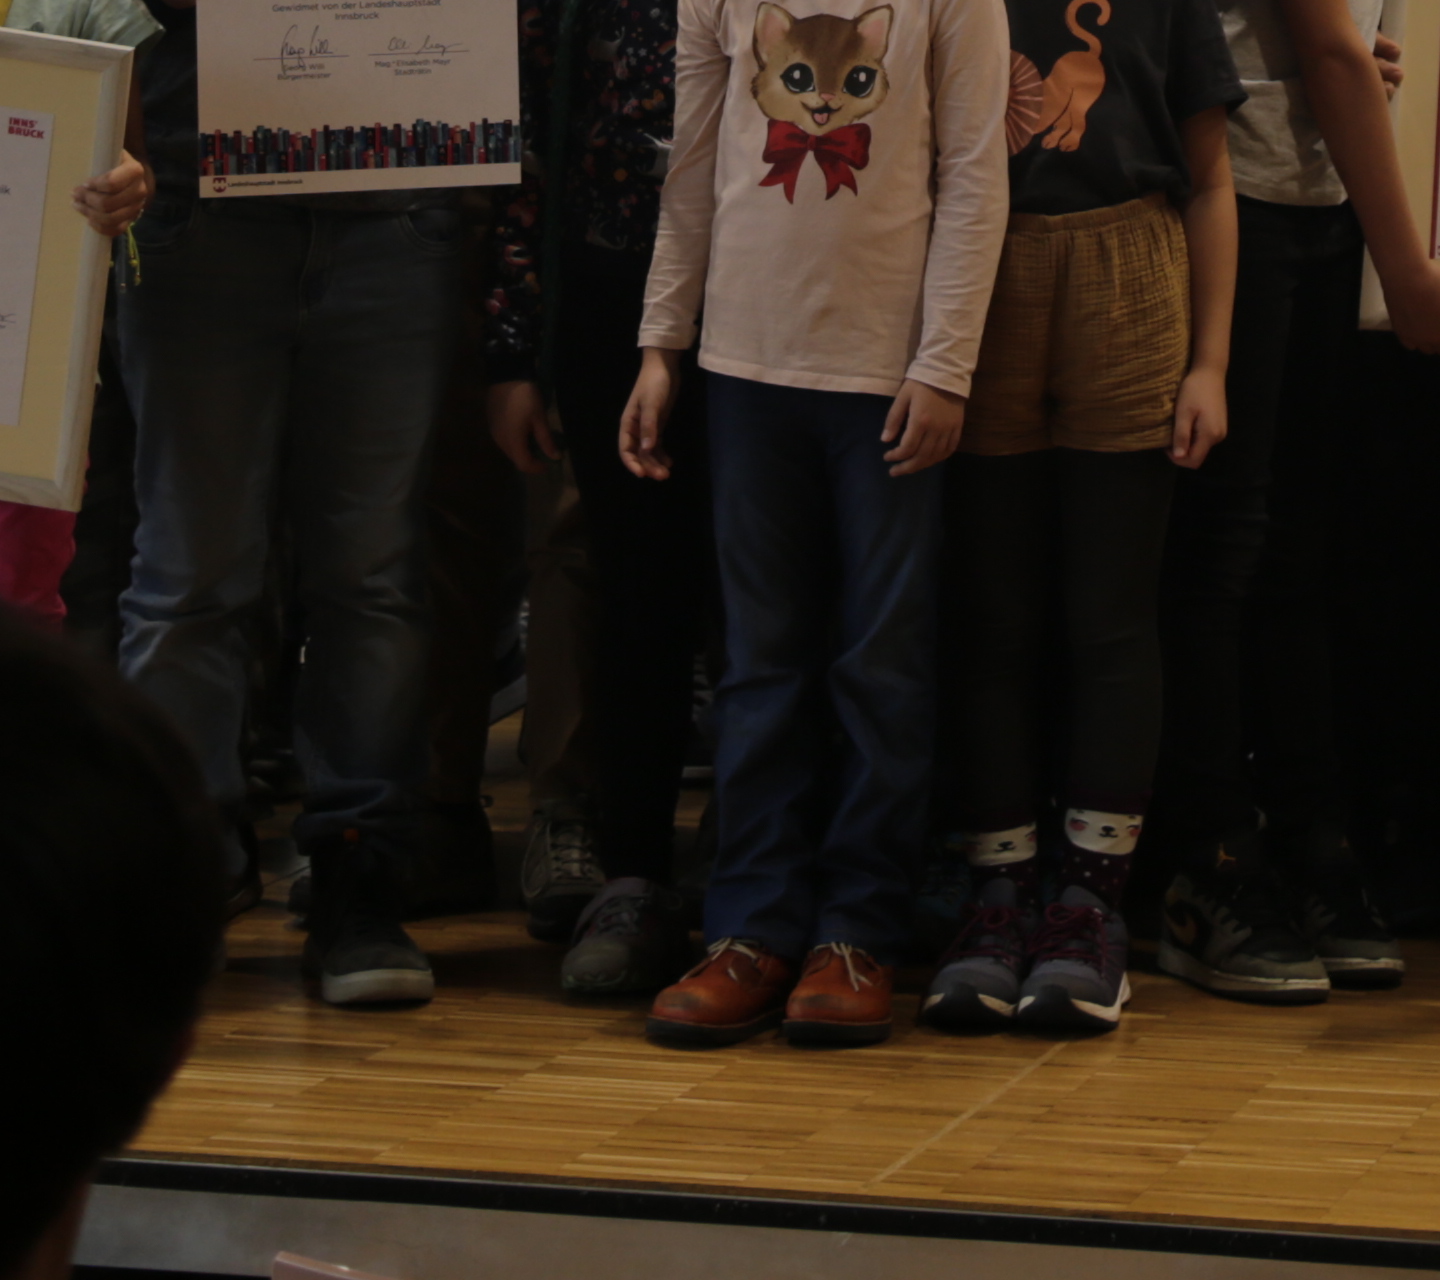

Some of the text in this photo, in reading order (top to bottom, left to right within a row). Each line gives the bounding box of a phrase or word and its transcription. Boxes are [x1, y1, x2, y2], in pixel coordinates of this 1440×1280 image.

[272, 3, 319, 13] Gewidmet
[341, 0, 357, 10] der
[335, 11, 380, 21] Innsbruck
[7, 126, 45, 139] BRUCK
